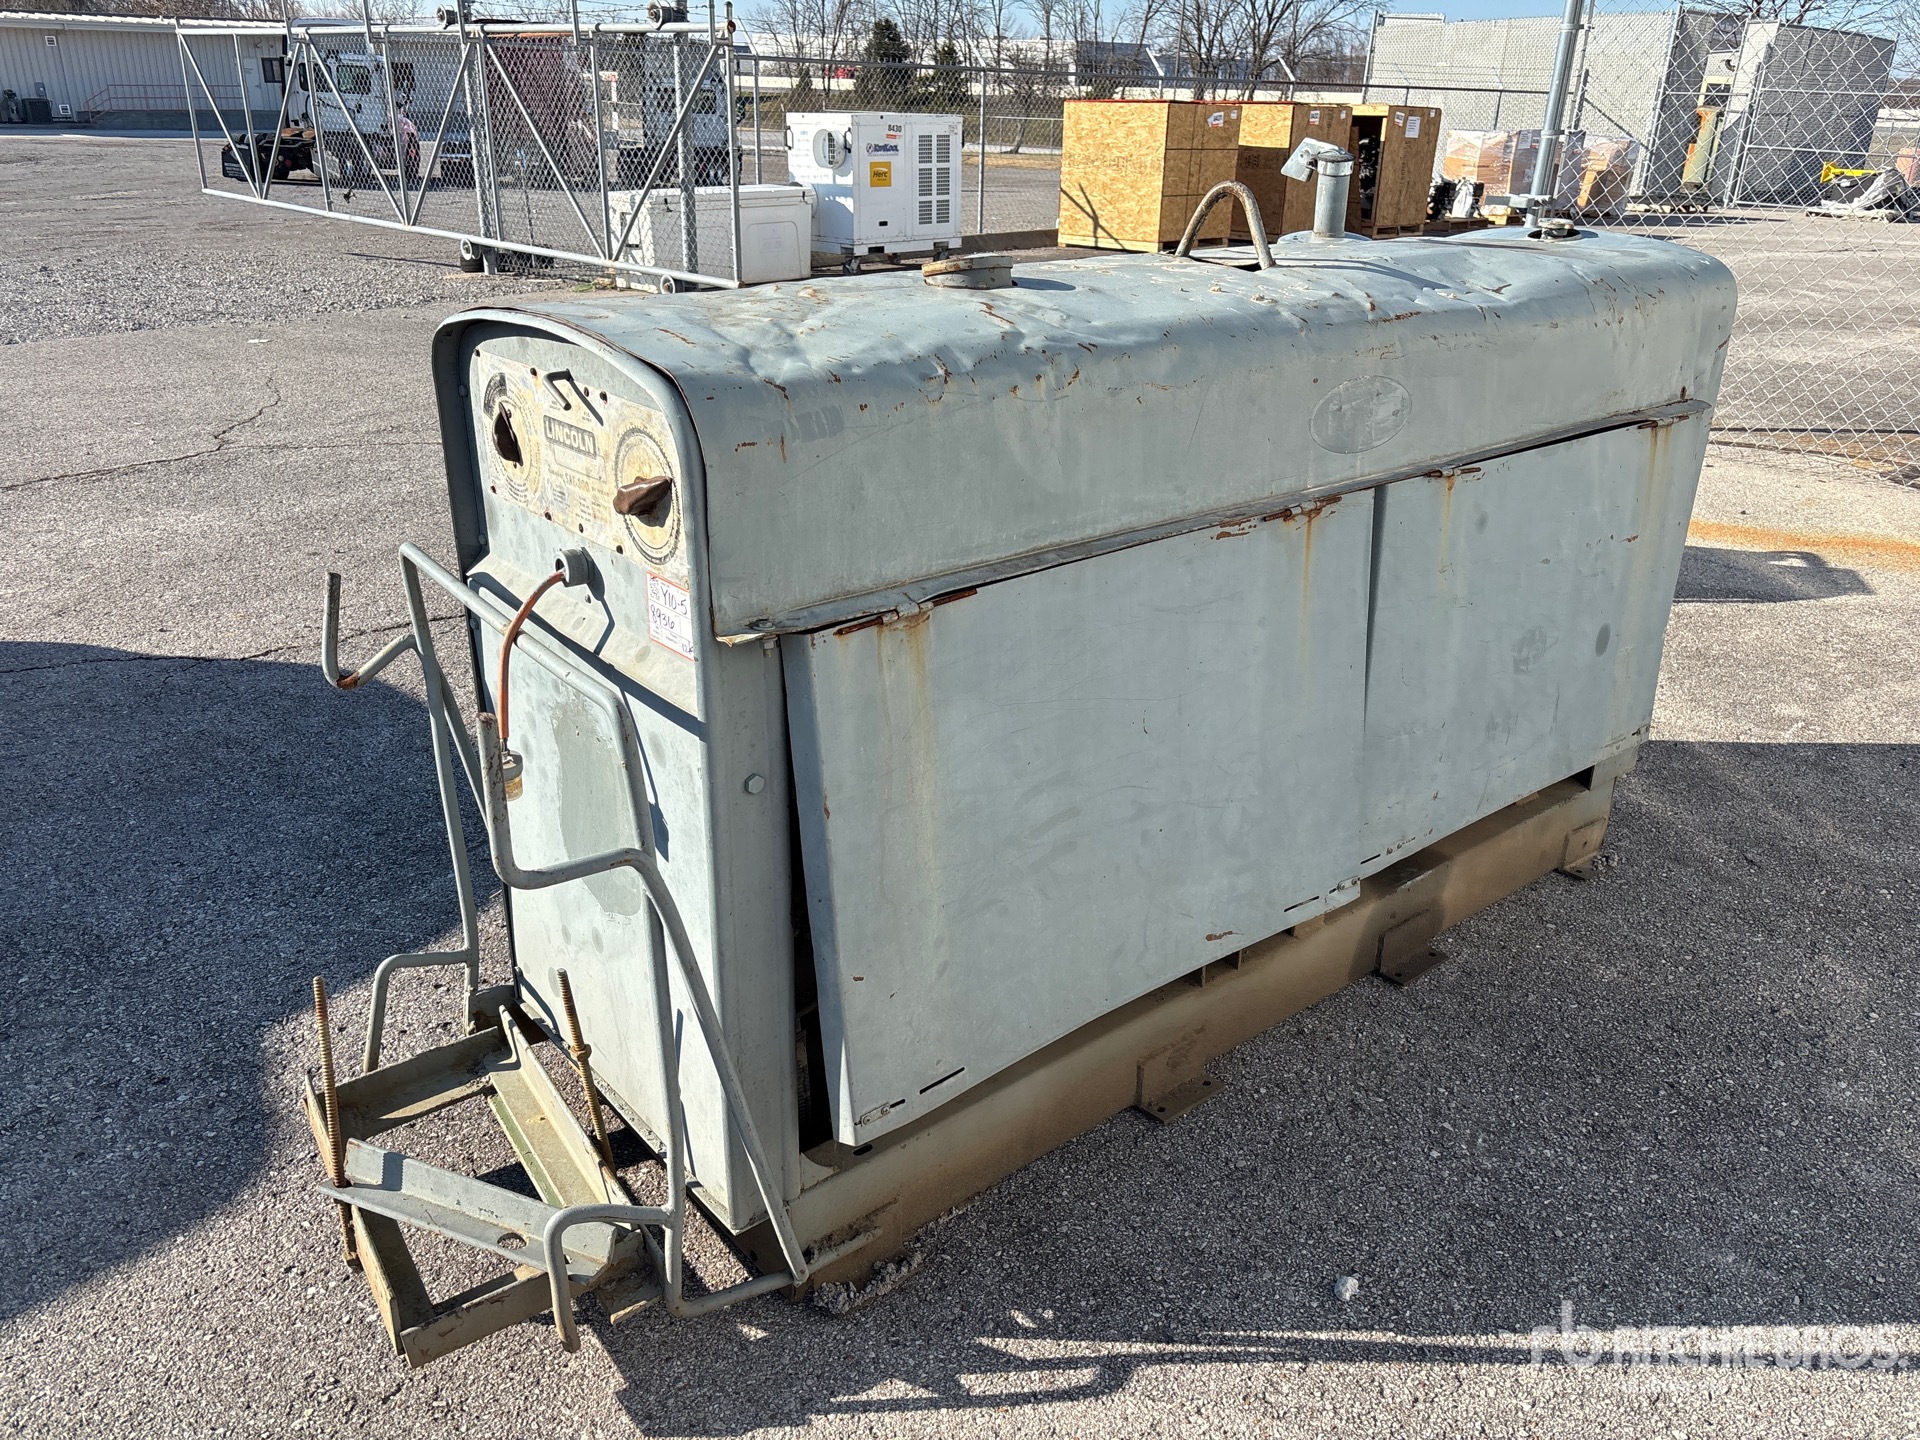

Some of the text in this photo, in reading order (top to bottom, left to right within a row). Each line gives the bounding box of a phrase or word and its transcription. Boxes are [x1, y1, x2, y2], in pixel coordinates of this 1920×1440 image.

[887, 124, 903, 133] 8430
[872, 170, 889, 178] Herc
[545, 419, 595, 455] LINCOLN
[660, 585, 688, 615] Y10-5
[650, 604, 675, 629] 8936
